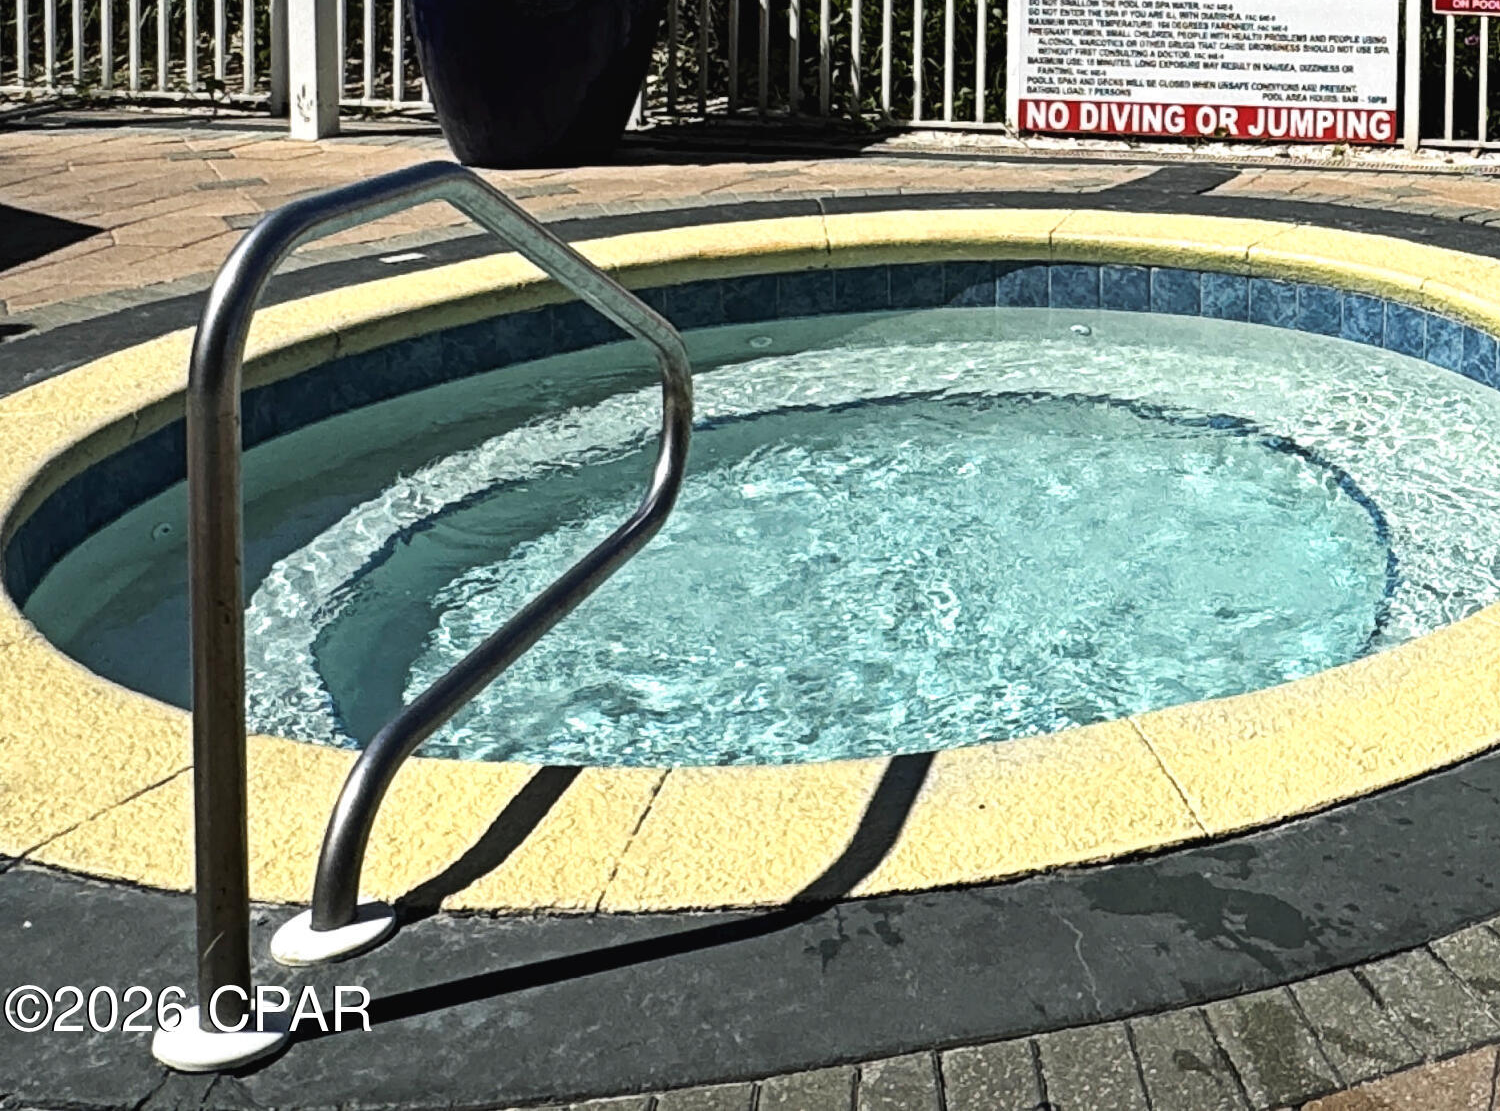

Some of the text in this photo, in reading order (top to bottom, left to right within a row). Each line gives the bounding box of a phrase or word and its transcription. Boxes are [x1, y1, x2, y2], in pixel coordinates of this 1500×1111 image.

[1453, 0, 1469, 9] ON
[1026, 101, 1391, 141] NO DIVING OR JUMPING
